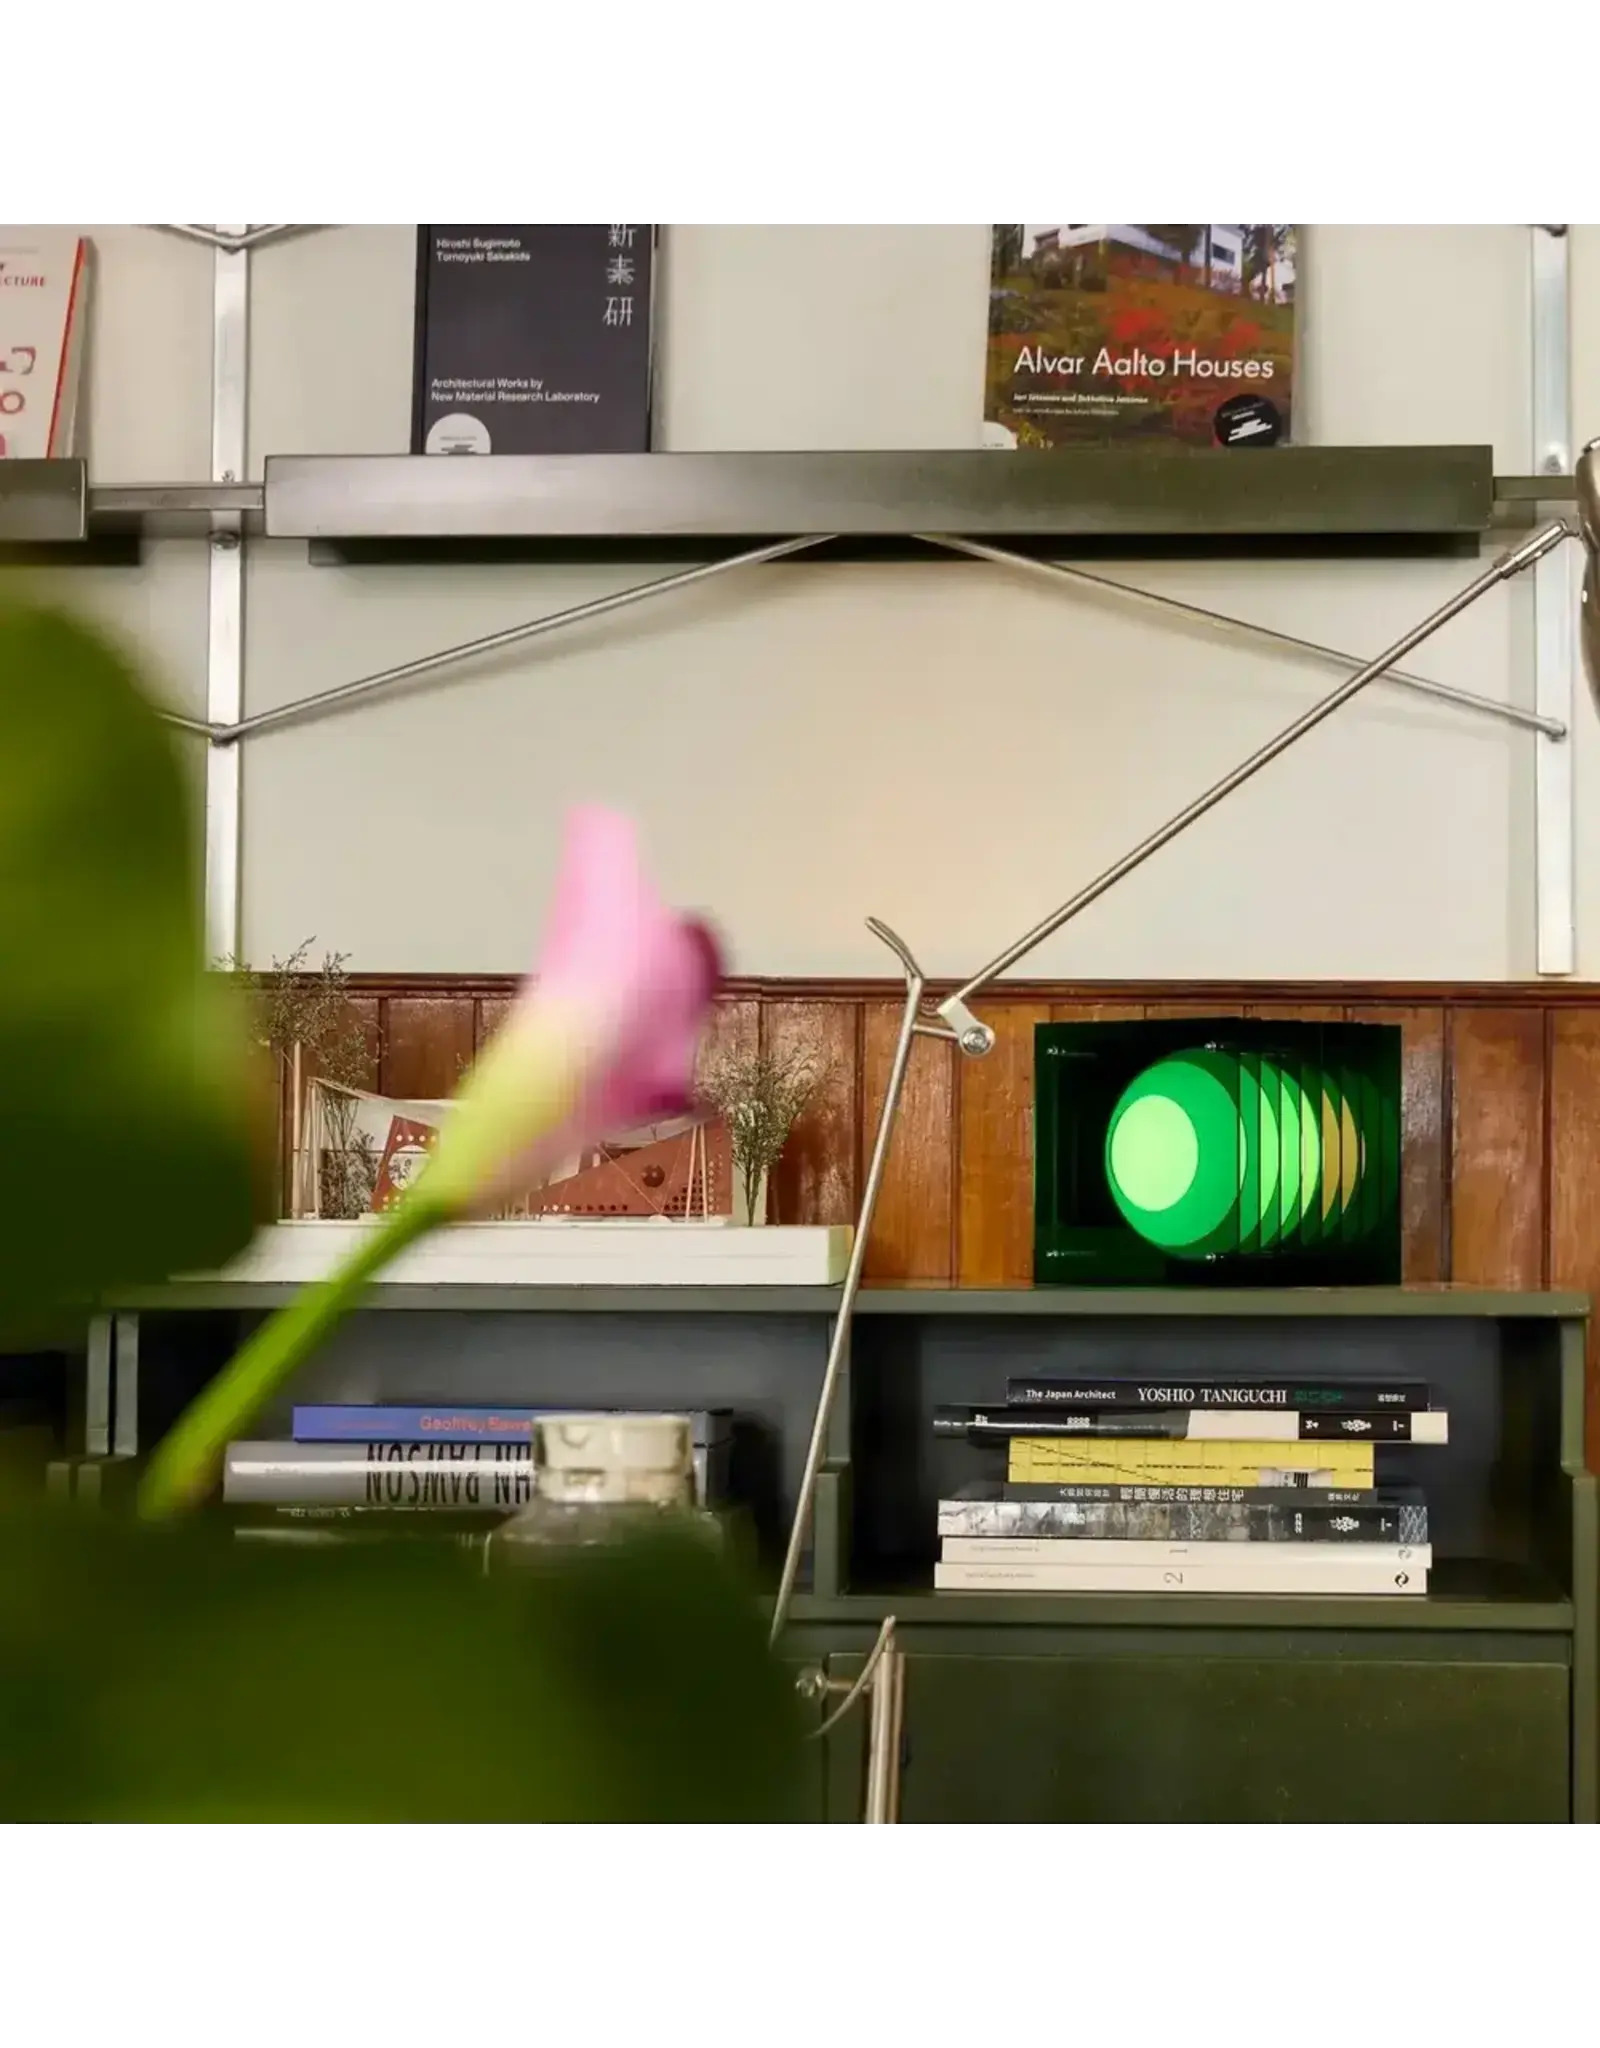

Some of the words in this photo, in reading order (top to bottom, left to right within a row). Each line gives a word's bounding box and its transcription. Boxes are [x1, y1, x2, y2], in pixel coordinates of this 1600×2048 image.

[1013, 345, 1084, 374] Alvar
[1092, 348, 1164, 377] Aalto
[1173, 348, 1274, 379] Houses
[431, 378, 495, 389] Architectural
[497, 378, 529, 389] Works
[530, 378, 543, 390] by
[431, 391, 453, 401] New
[455, 391, 496, 402] Material
[499, 391, 543, 402] Research
[545, 391, 600, 403] Laboratory
[1026, 1389, 1043, 1399] The
[1044, 1390, 1073, 1401] Japan
[1074, 1389, 1116, 1400] Architect
[1138, 1388, 1195, 1402] YOSHIO
[1201, 1388, 1287, 1403] TANIGUCHI
[1163, 1572, 1183, 1584] 2
